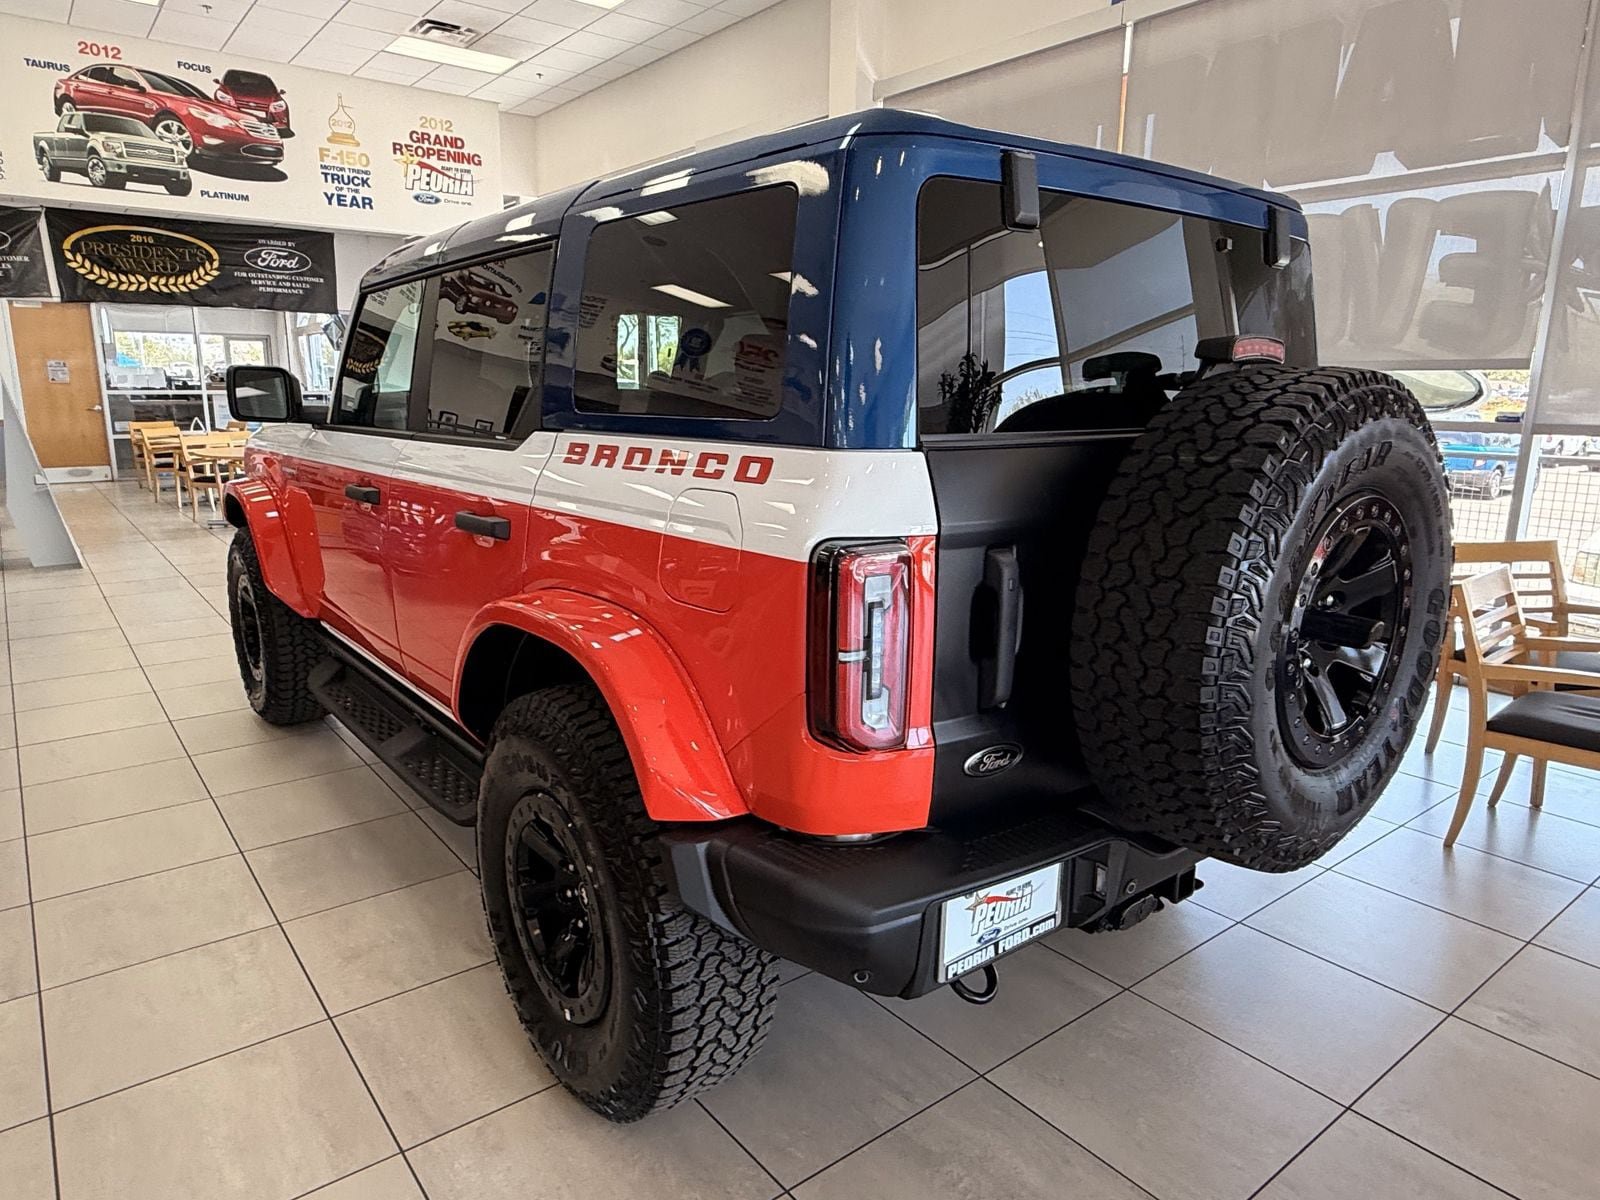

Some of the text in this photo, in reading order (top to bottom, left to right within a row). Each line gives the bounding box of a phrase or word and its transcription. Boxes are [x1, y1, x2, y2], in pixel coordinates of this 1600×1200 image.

[77, 40, 123, 61] 2012
[23, 57, 71, 73] TAURUS
[177, 60, 212, 74] FOCUS
[331, 118, 353, 129] 2012
[419, 116, 454, 133] 2012
[409, 130, 465, 150] GRAND
[318, 147, 370, 168] F-150
[392, 142, 482, 167] REOPENING
[320, 164, 371, 176] MOTOR TREND
[321, 171, 372, 188] TRUCK
[404, 163, 474, 197] PEORIA
[200, 190, 250, 202] PLATINUM
[335, 185, 361, 195] OF THE
[323, 192, 374, 210] YEAR
[130, 234, 155, 244] 2016
[80, 241, 208, 263] PRESIDENT'S
[257, 249, 300, 269] Ford
[116, 257, 180, 274] AWARD
[248, 272, 291, 281] OUTSTANDING
[292, 275, 325, 283] CUSTOMER
[291, 281, 311, 289] SALES
[562, 441, 774, 485] BRONCO
[979, 751, 1012, 772] Ford
[970, 884, 1034, 937] PEORIA
[947, 918, 1055, 980] PEORIA FORD.com
